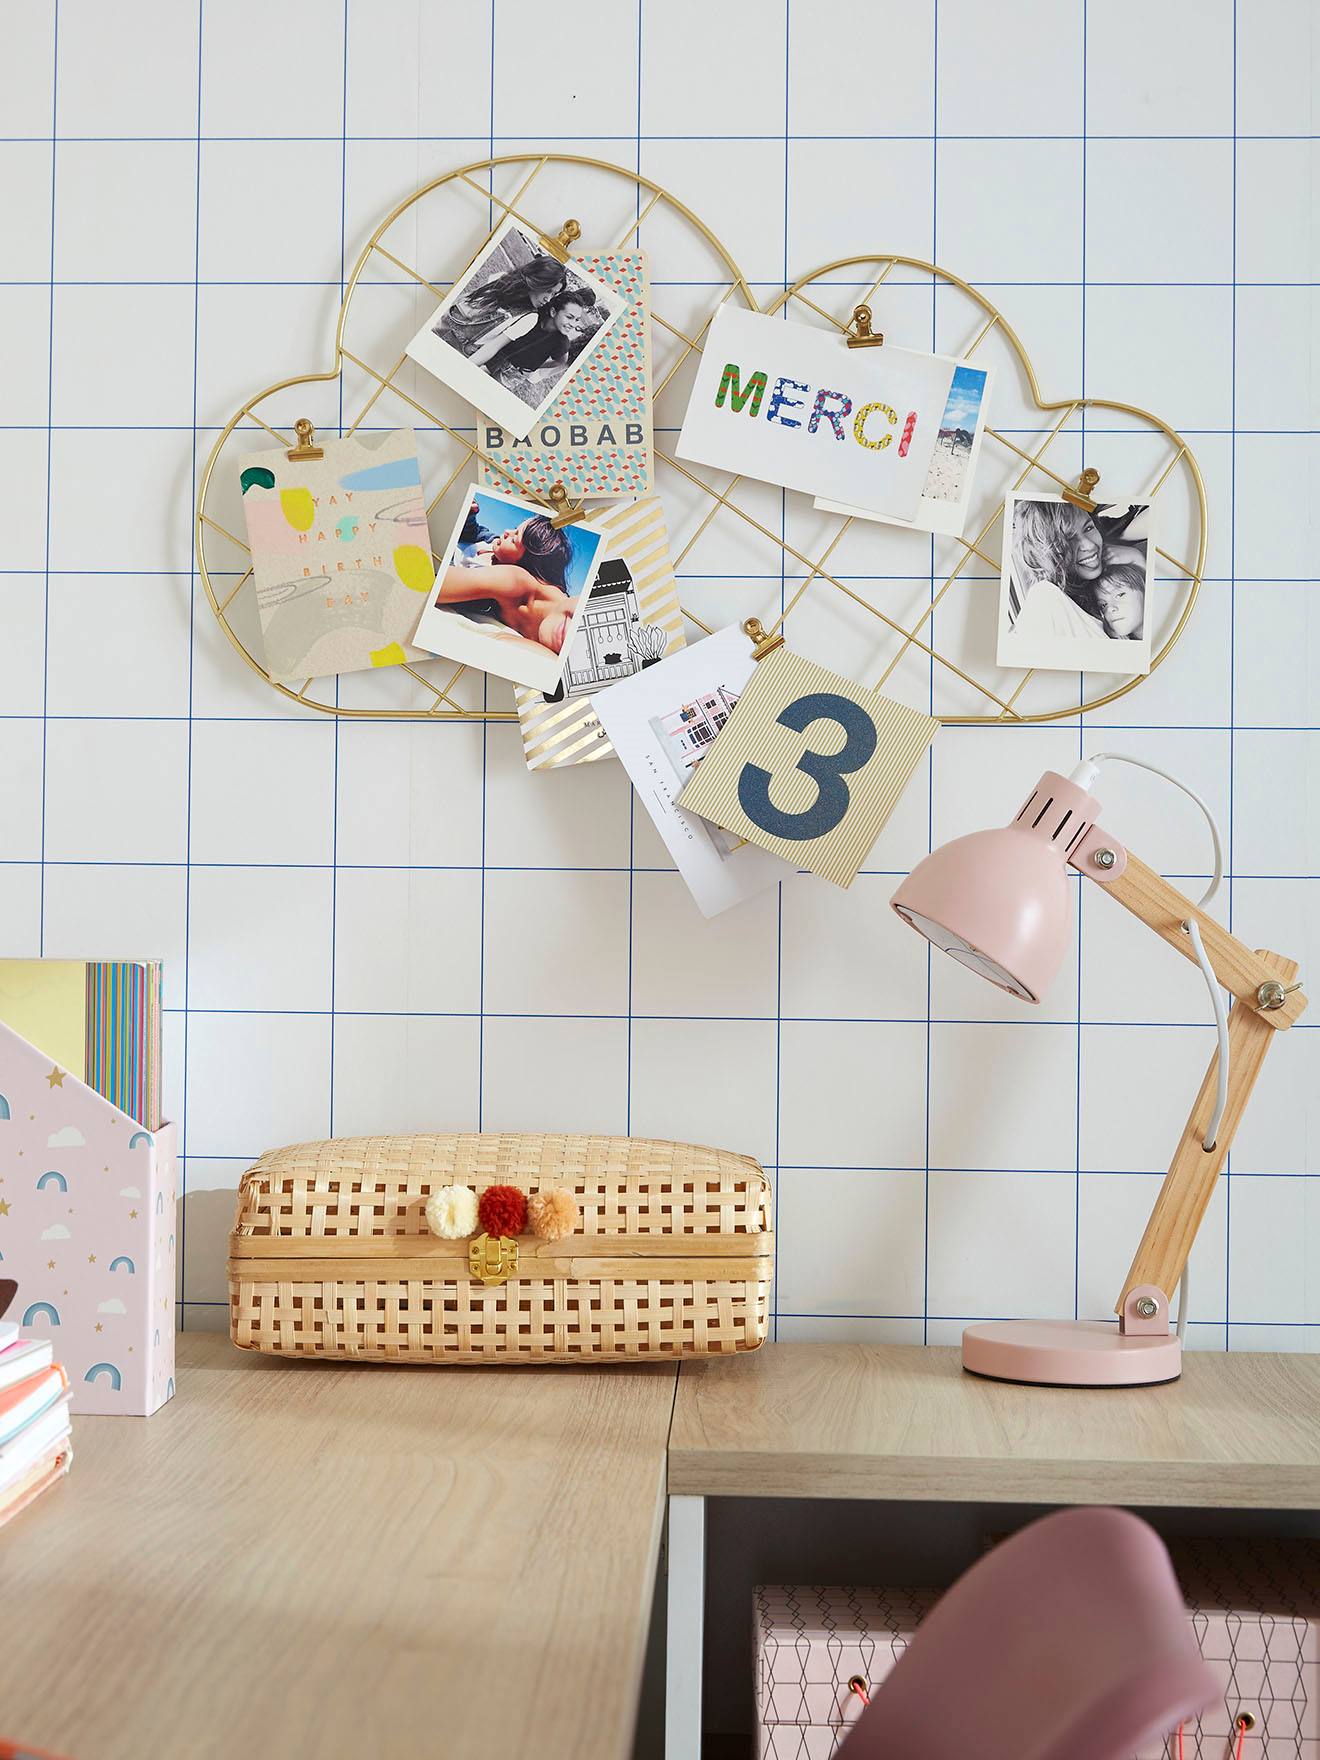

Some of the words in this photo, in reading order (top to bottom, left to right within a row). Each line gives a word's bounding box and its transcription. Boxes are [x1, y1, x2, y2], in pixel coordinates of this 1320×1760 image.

[715, 363, 918, 458] MERCI
[312, 493, 353, 507] YAY
[298, 523, 376, 543] HAPPY
[304, 557, 383, 576] BIRTH
[738, 692, 878, 841] 3
[645, 754, 657, 774] SAN
[660, 780, 694, 840] FRANCISCO
